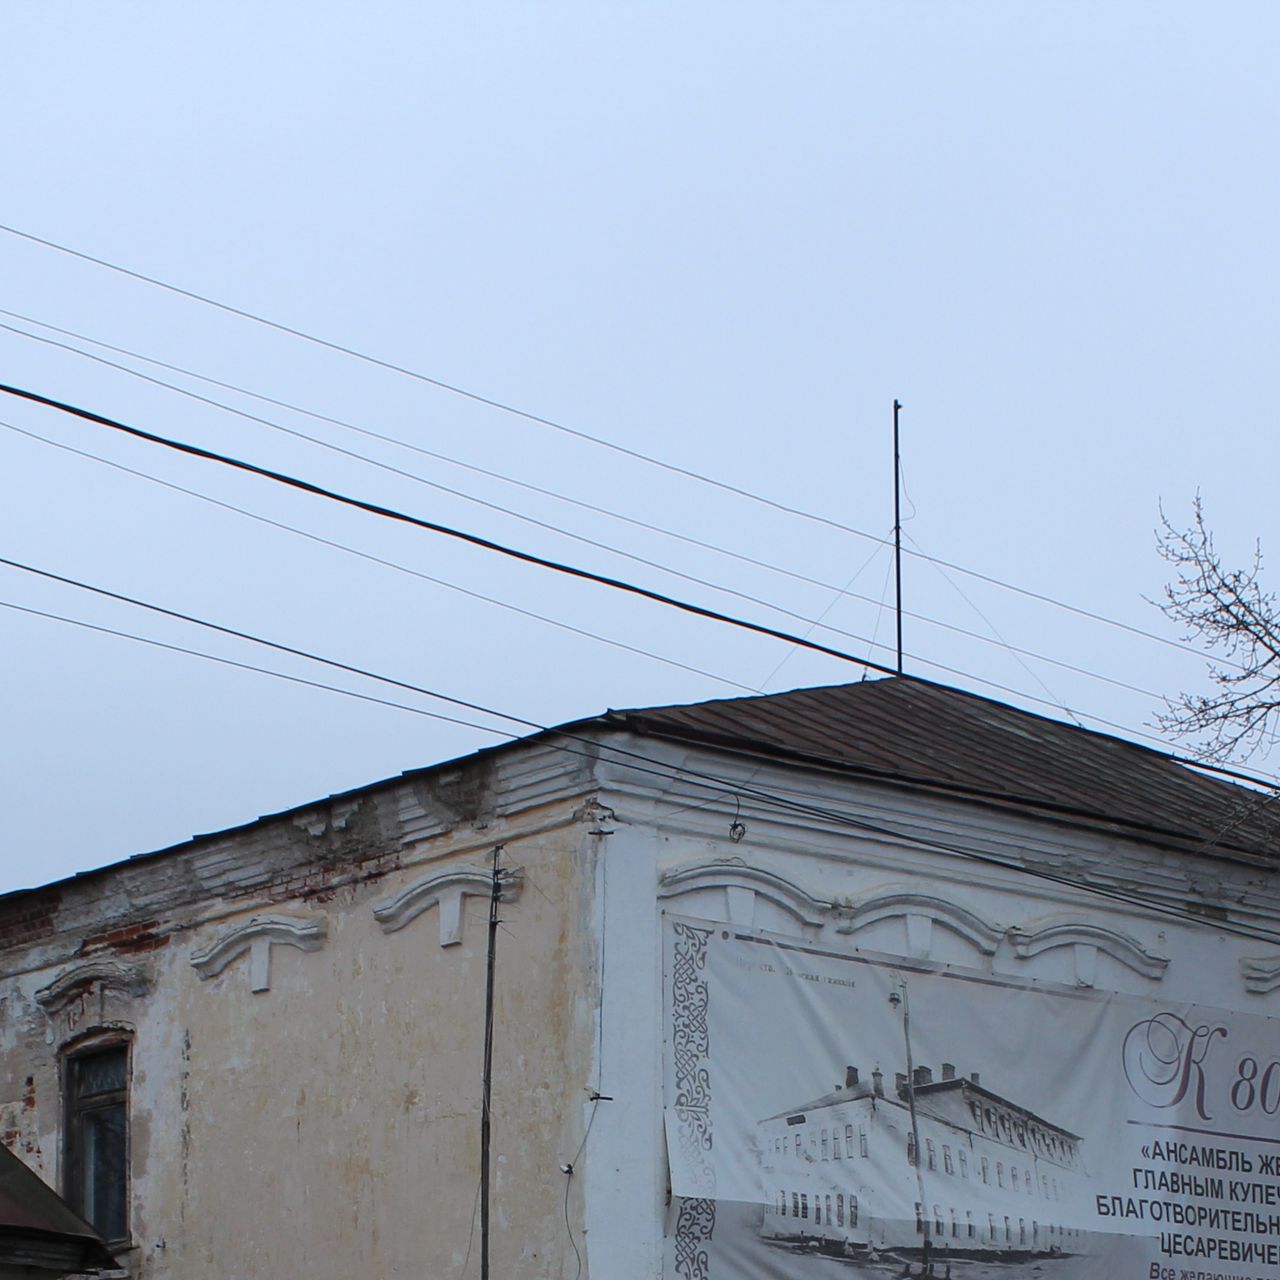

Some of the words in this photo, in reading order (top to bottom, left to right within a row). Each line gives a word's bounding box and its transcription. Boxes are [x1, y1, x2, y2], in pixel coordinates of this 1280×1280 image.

[1121, 1011, 1228, 1121] К
[1141, 1140, 1253, 1173] «АНСАМБЛЬ
[1132, 1168, 1224, 1199] ГЛАВНЫМ
[1149, 1262, 1176, 1280] Все
